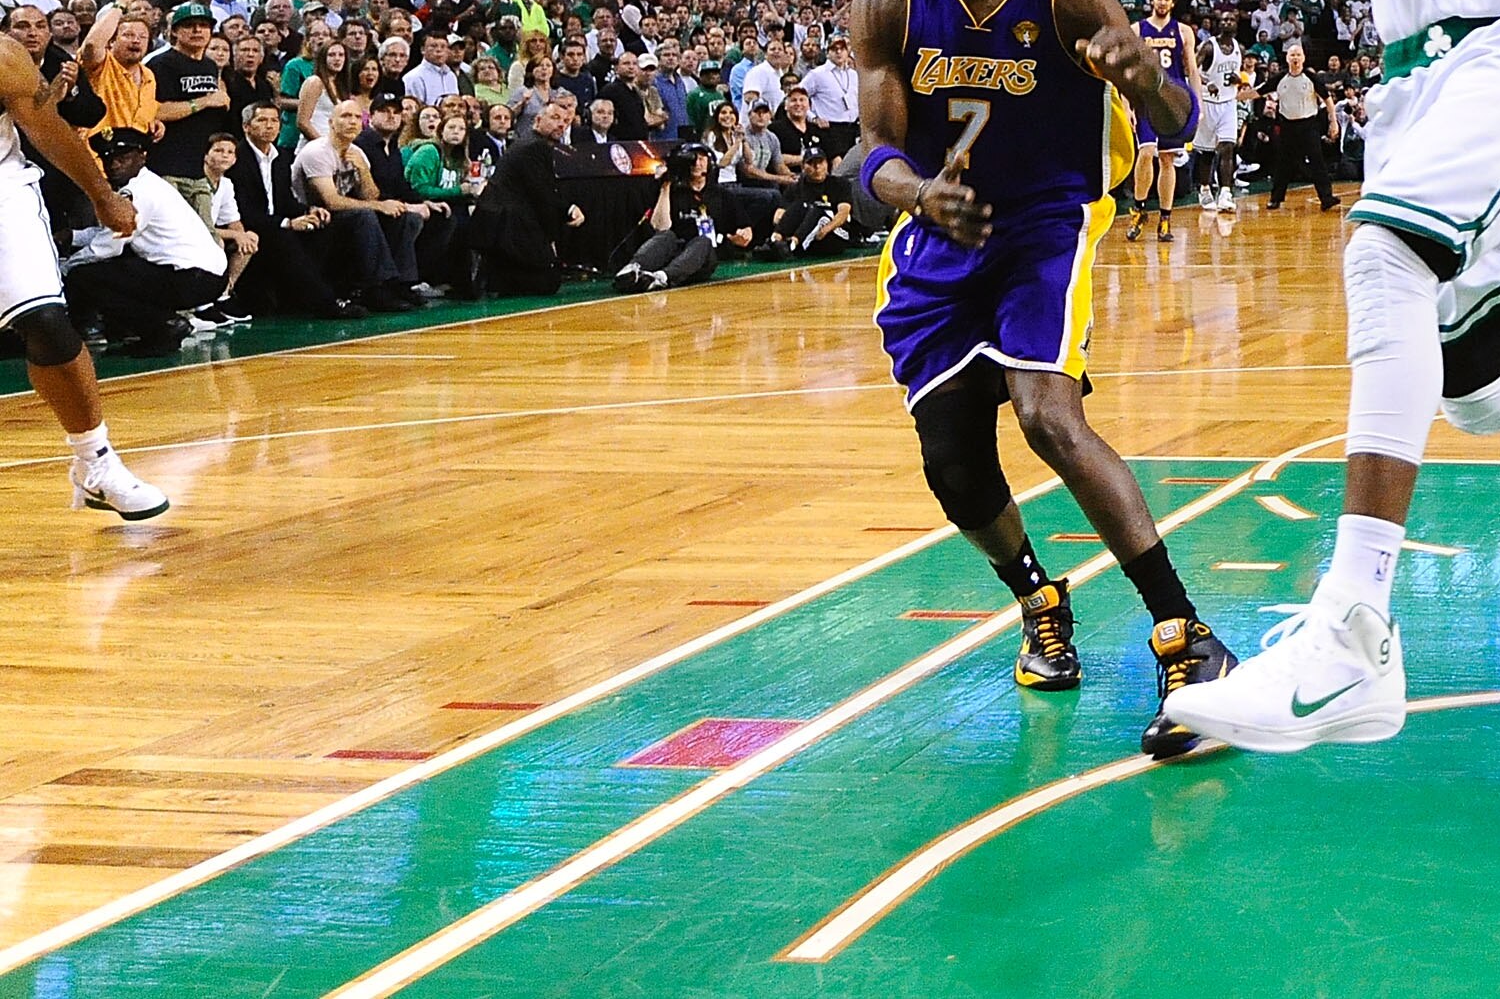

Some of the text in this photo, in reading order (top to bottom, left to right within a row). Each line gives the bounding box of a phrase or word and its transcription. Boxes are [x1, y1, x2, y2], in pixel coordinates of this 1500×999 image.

[912, 47, 1039, 97] LAKERS
[945, 97, 991, 171] 7
[1379, 638, 1390, 666] 9
